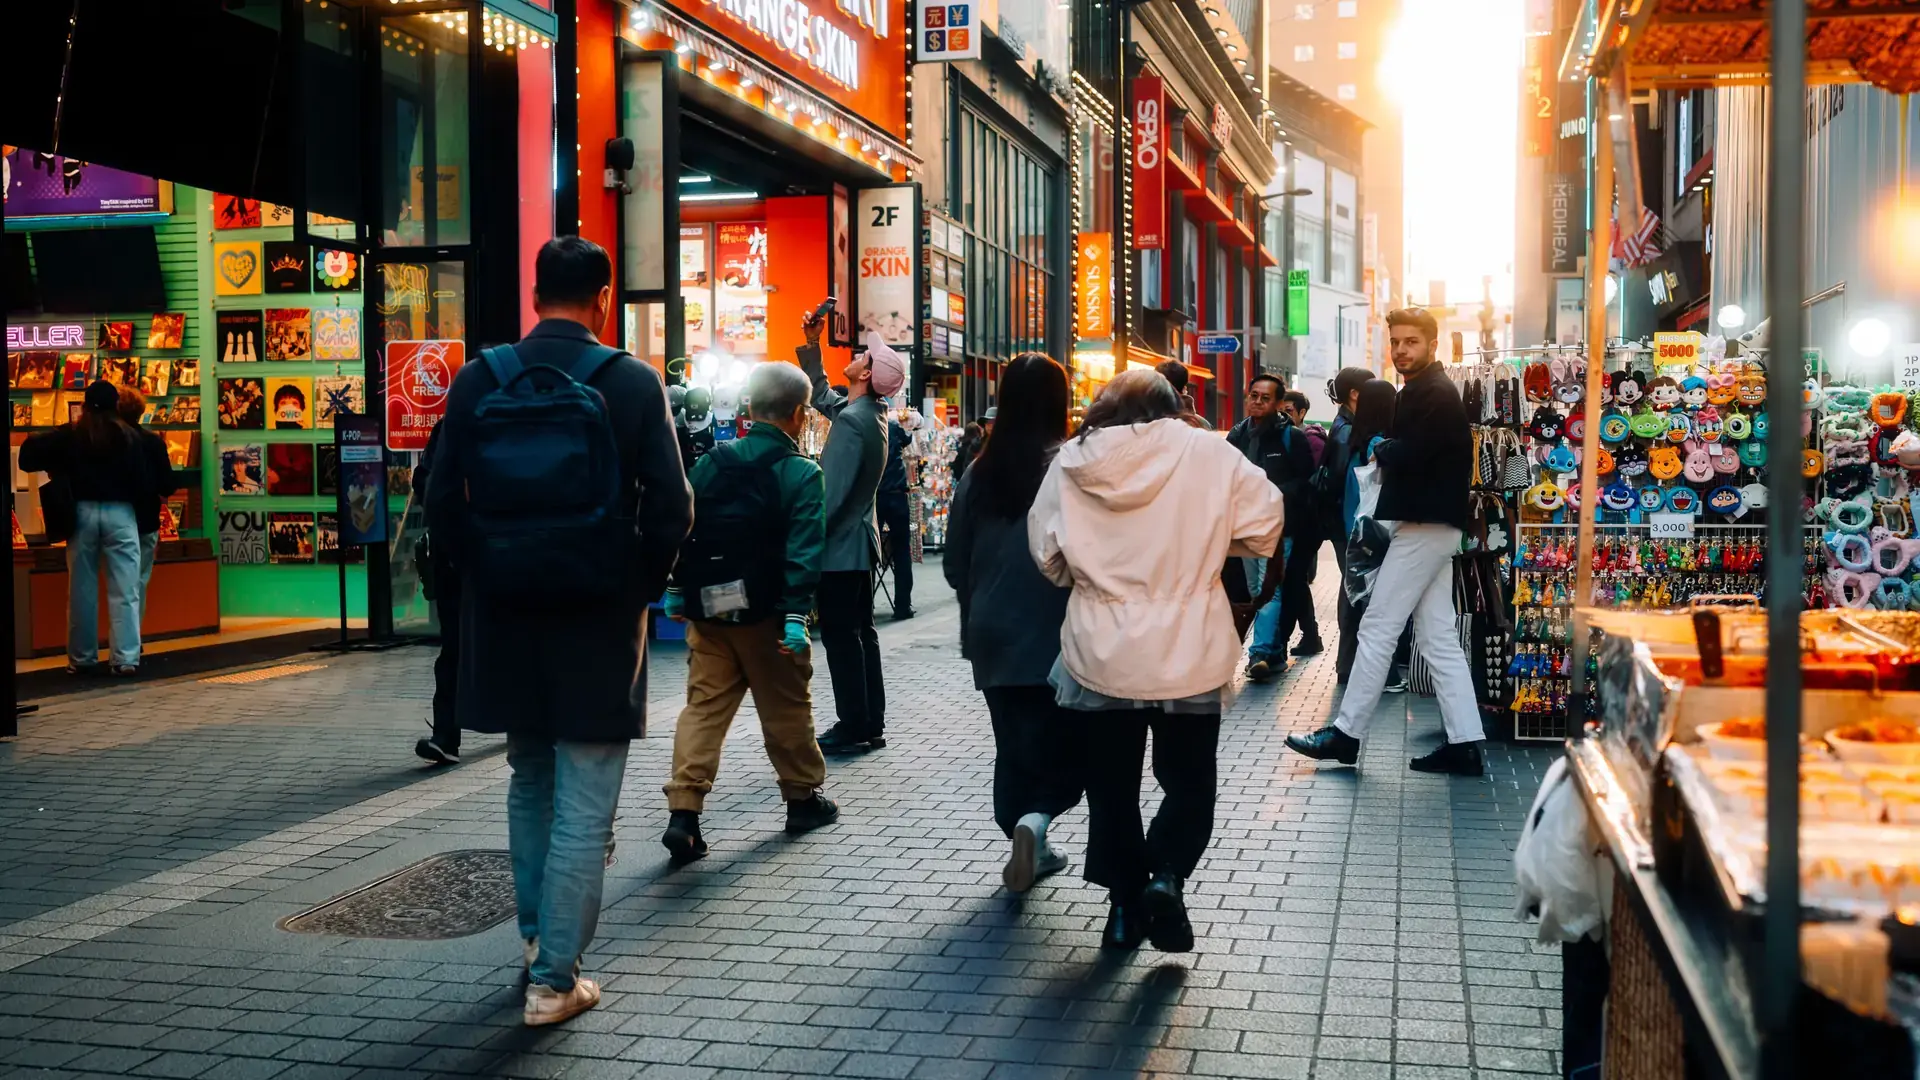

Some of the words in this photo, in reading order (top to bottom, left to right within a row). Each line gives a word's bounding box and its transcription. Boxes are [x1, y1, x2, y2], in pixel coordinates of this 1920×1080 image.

[928, 9, 941, 25] 元
[952, 6, 963, 25] ¥
[929, 32, 940, 51] $
[814, 15, 858, 91] SKIN
[1137, 99, 1158, 169] SPAO
[1560, 116, 1587, 139] JUNO
[872, 206, 899, 227] 2F
[1552, 183, 1567, 269] MEDIHEAL
[865, 247, 907, 256] ORANGE
[861, 257, 911, 278] SKIN
[1086, 265, 1100, 331] SUNSKIN
[1660, 344, 1694, 357] 5000
[1904, 356, 1919, 365] 1P
[412, 371, 441, 385] TAX
[1904, 368, 1919, 377] 2P
[342, 430, 360, 441] K-POP
[219, 512, 265, 531] YOU
[1652, 523, 1685, 533] 3,000
[220, 543, 265, 565] HAD
